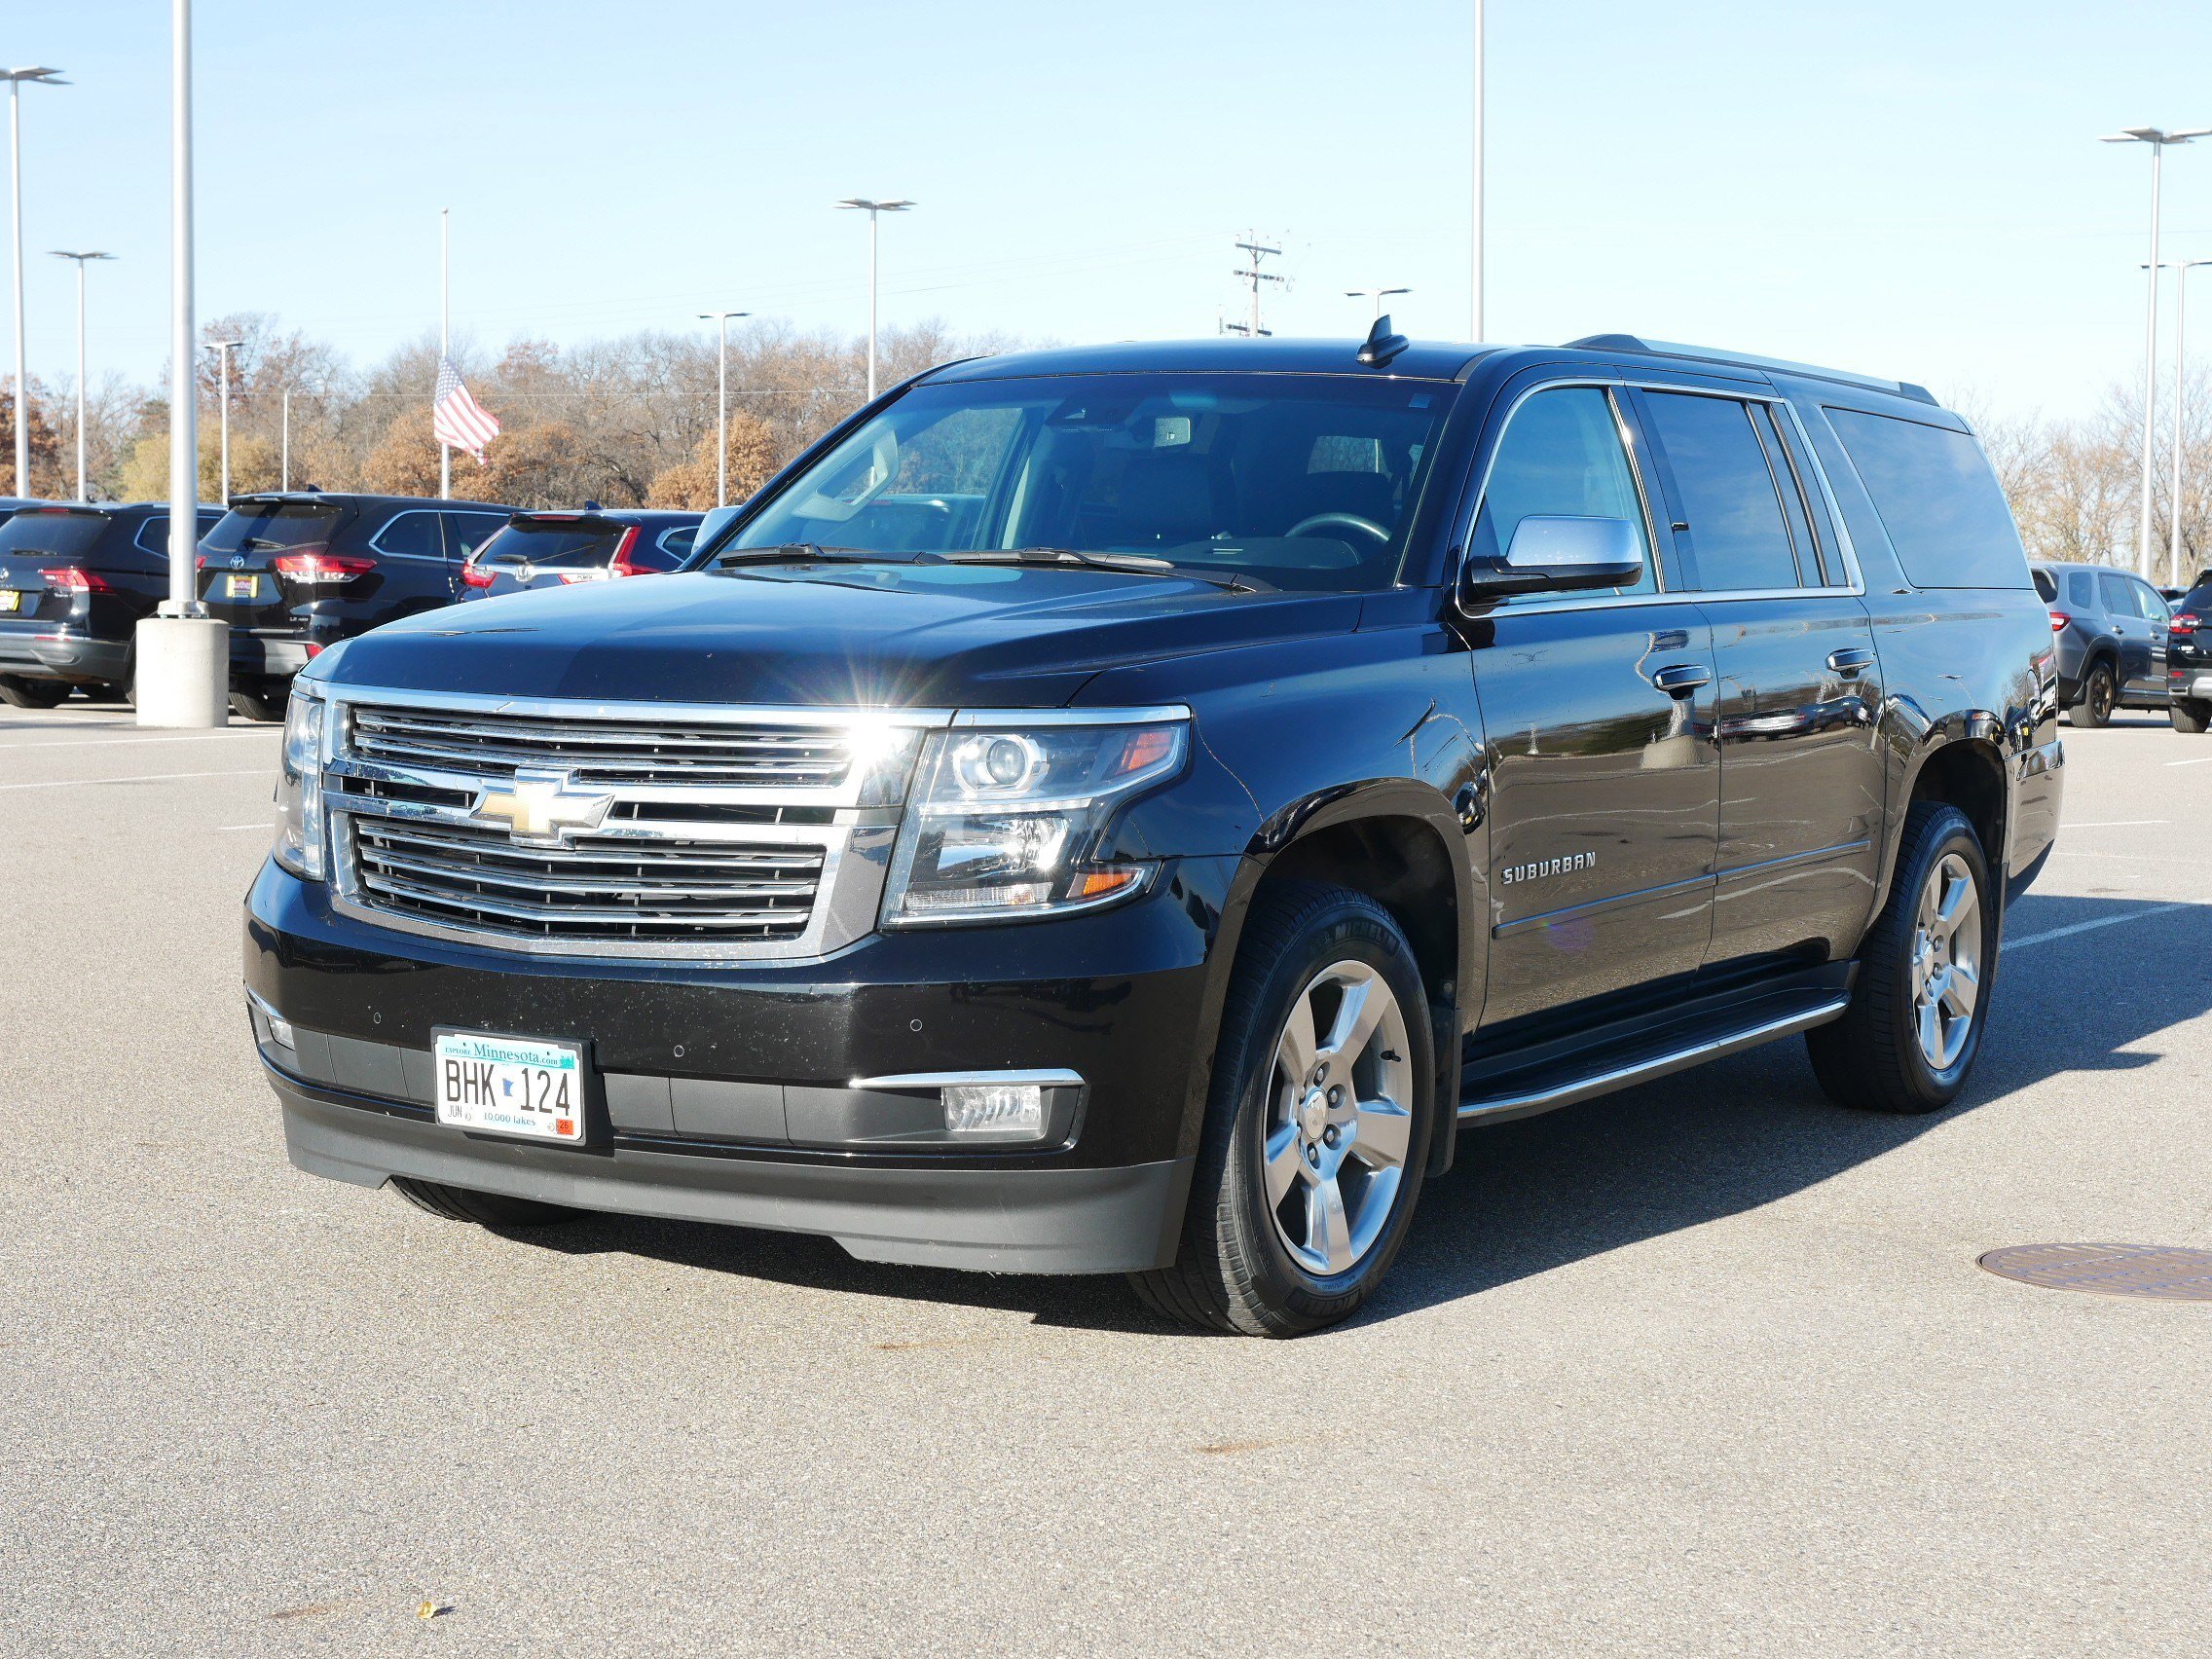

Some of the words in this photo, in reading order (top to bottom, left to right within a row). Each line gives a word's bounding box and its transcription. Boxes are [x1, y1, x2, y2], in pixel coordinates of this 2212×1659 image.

[1501, 852, 1597, 885] SUBURBAN
[445, 1047, 471, 1056] EXPLORE
[472, 1042, 559, 1066] Minnesota.com
[445, 1058, 498, 1107] BHK
[520, 1067, 571, 1117] 124
[447, 1104, 463, 1119] JUN
[483, 1111, 511, 1124] 10,000
[512, 1115, 537, 1127] lakes
